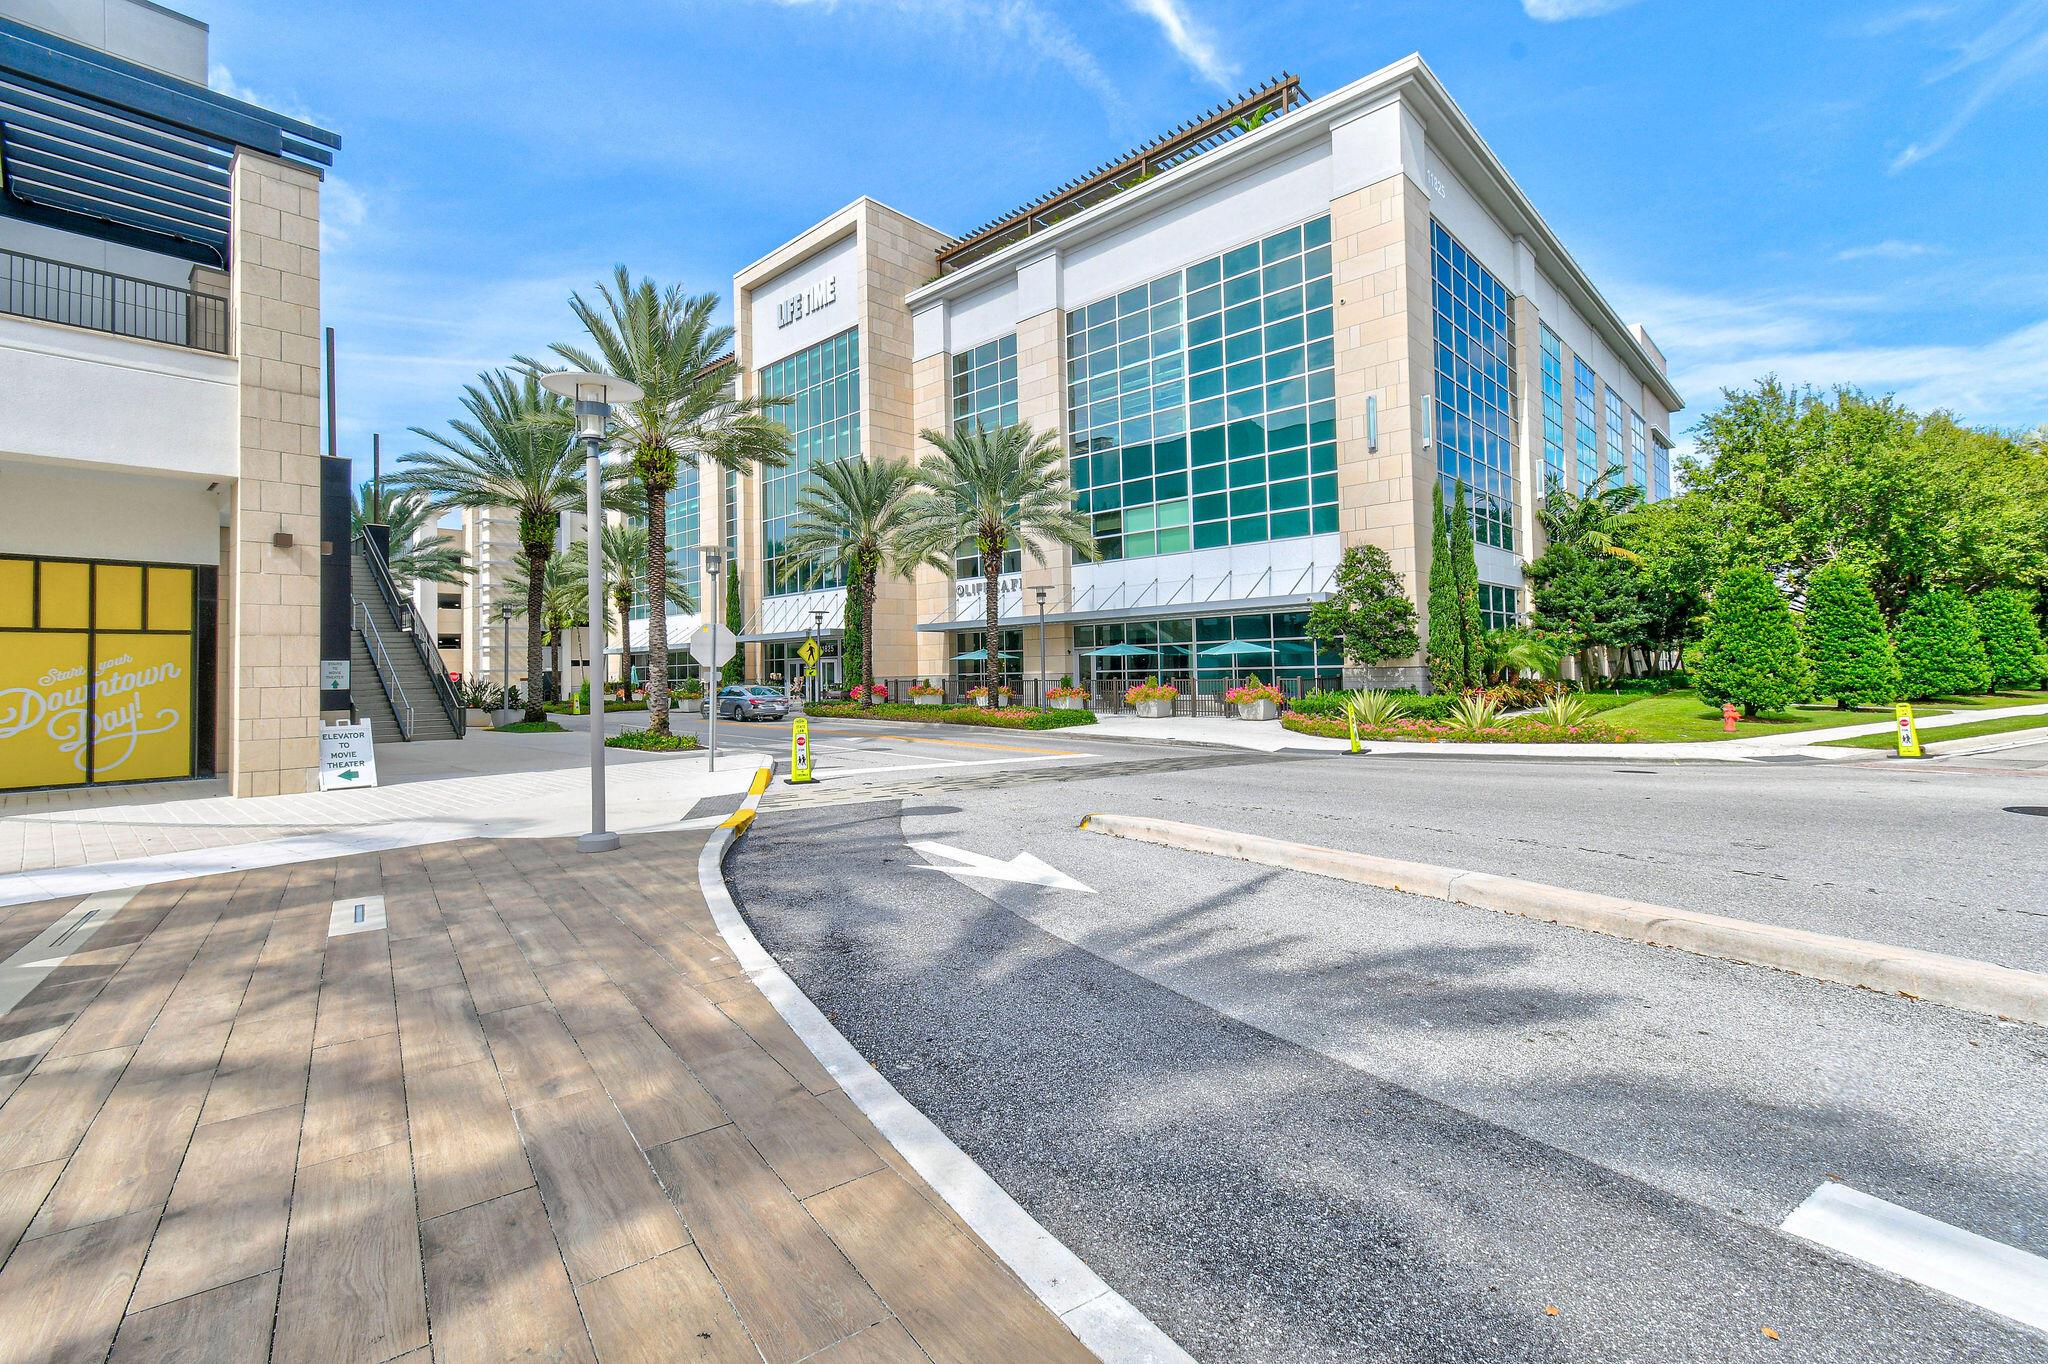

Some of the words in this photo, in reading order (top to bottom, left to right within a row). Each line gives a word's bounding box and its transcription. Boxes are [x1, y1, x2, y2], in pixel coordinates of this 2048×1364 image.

[777, 292, 803, 330] LIFE
[803, 274, 837, 316] TIME
[38, 667, 87, 687] Start
[93, 653, 134, 676] your
[0, 662, 182, 739] Downtown
[47, 691, 179, 773] Day!
[322, 732, 365, 740] ELEVATOR
[326, 761, 365, 769] THEATER
